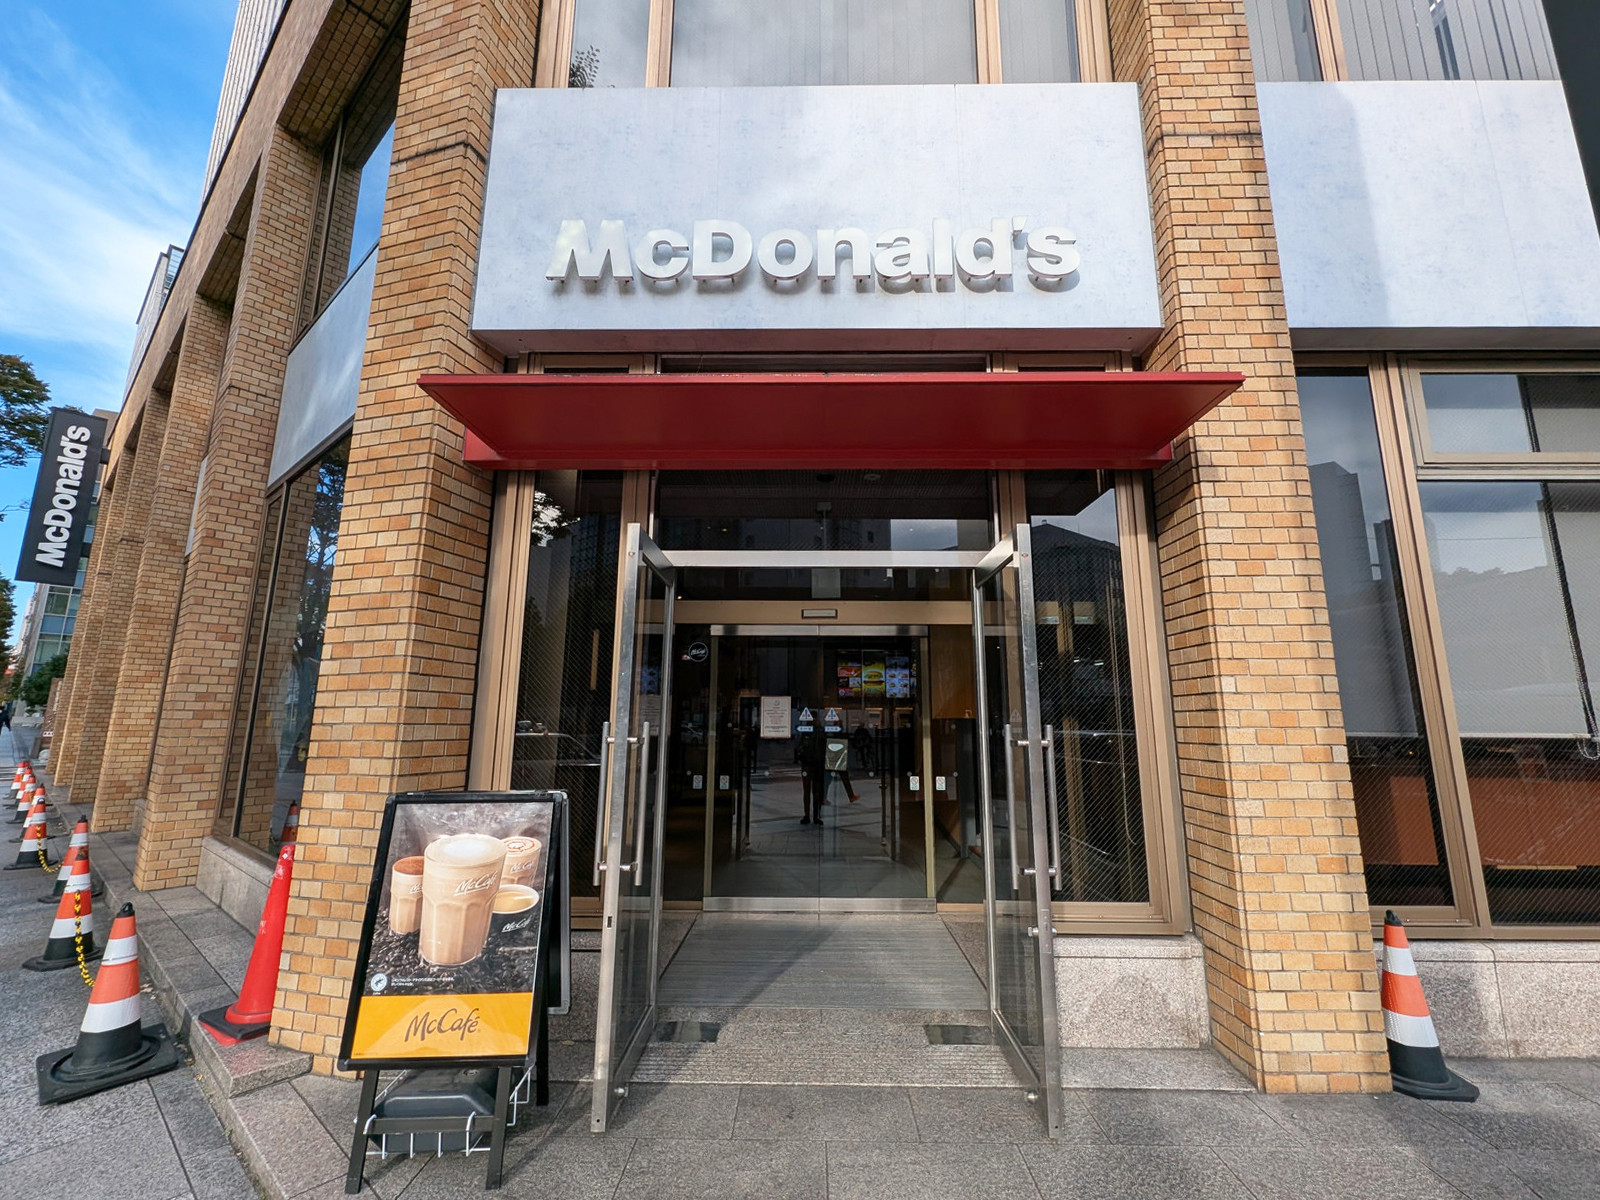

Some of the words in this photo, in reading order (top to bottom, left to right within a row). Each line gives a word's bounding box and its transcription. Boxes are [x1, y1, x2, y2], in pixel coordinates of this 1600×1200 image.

[545, 216, 1081, 282] McDonald's
[35, 425, 91, 567] McDonald's
[404, 1008, 480, 1042] McCafé
